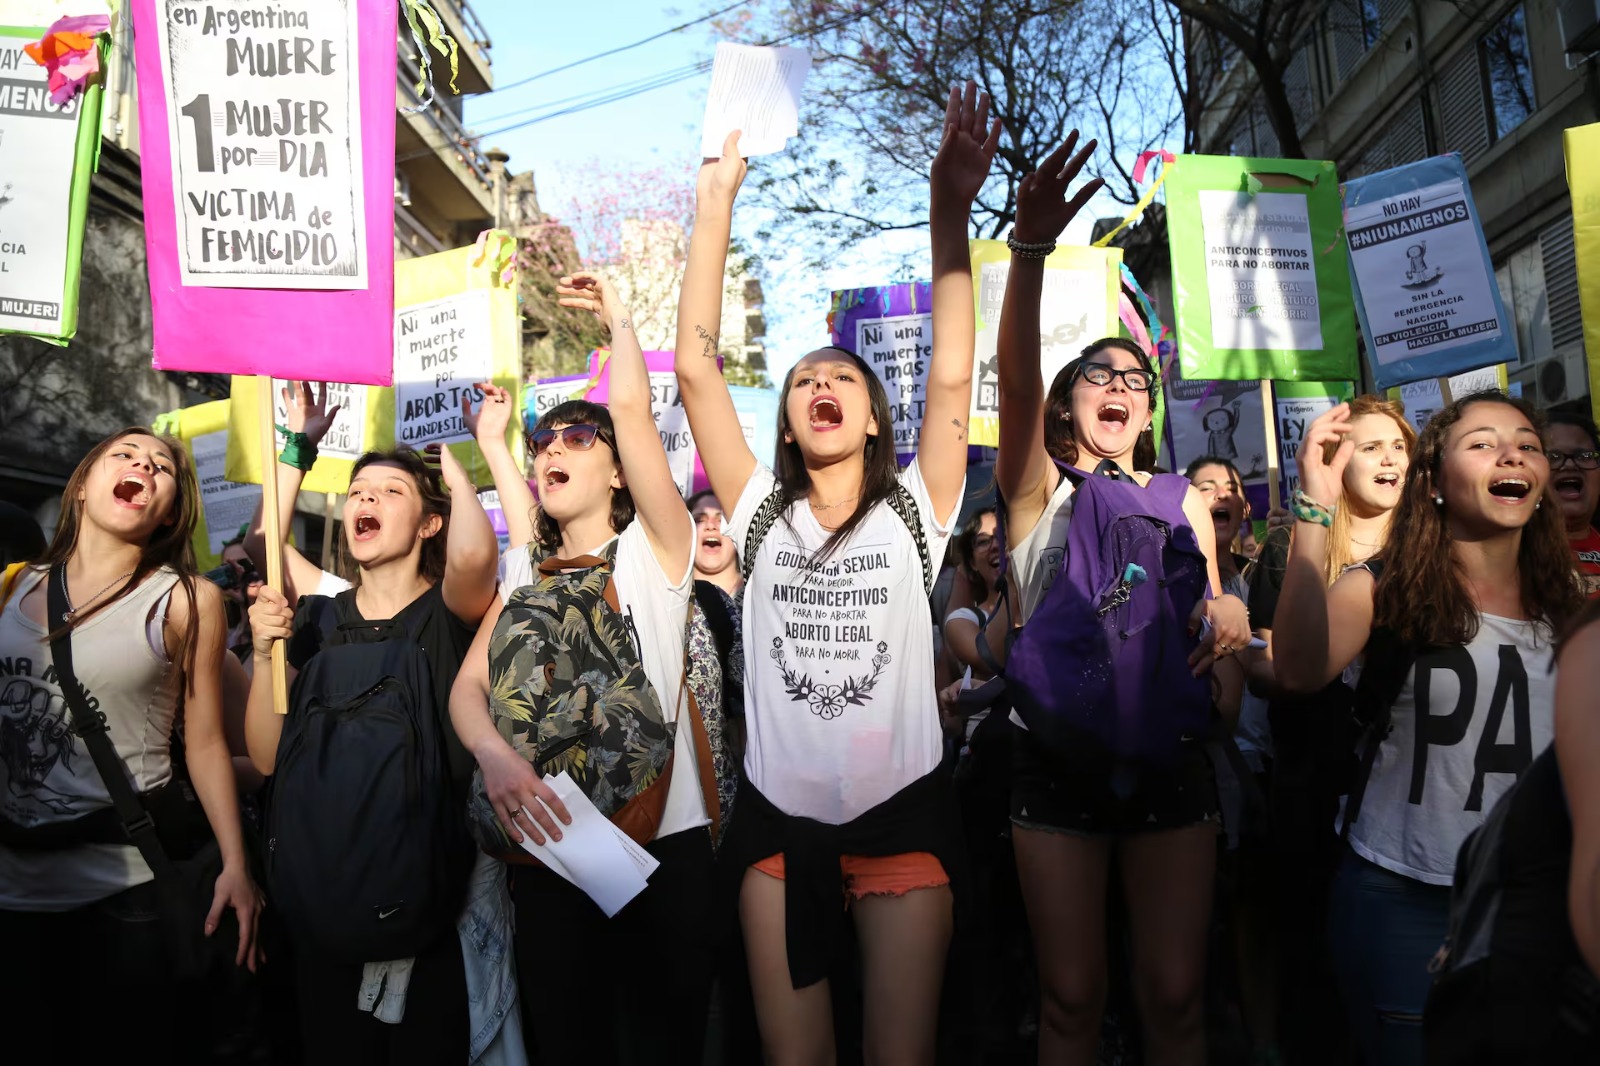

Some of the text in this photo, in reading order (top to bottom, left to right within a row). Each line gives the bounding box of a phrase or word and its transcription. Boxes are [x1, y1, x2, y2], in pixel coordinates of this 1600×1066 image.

[173, 5, 309, 35] en Argentina
[226, 37, 336, 77] MUERE
[181, 94, 333, 173] 1 MUJER
[221, 139, 328, 178] por DIA
[188, 188, 332, 229] VICTIMA de
[1382, 196, 1421, 217] NO HAY
[1351, 204, 1466, 248] #NIUNAMENOS
[201, 227, 337, 266] FEMICIDIO
[1211, 246, 1308, 257] ANTICONCEPTIVOS
[1211, 259, 1310, 271] PARA NO ABORTAR
[1394, 295, 1464, 318] #EMERGENCIA
[1411, 289, 1444, 302] SIN LA
[2, 300, 57, 317] MUJER!
[1406, 308, 1457, 326] NACIONAL
[401, 308, 457, 336] Ni una
[410, 328, 465, 353] muerte
[864, 327, 922, 346] Ni una
[1376, 322, 1447, 346] EN VIOLENCIA
[1408, 320, 1496, 349] HACIA LA MUJER!
[421, 345, 458, 371] mas
[873, 344, 932, 363] muerte
[436, 370, 455, 388] por
[884, 360, 924, 381] mas
[900, 384, 921, 399] por
[403, 386, 485, 422] ABORTOS
[843, 552, 890, 574] SEXUAL
[804, 575, 854, 588] PARA DECIDIR
[773, 584, 888, 607] ANTICONCEPTIVOS
[792, 607, 812, 619] PARA
[830, 610, 867, 621] ABORTAR
[785, 621, 873, 643] ABORTO LEGAL
[796, 646, 815, 658] PARA
[833, 648, 860, 660] MORIR
